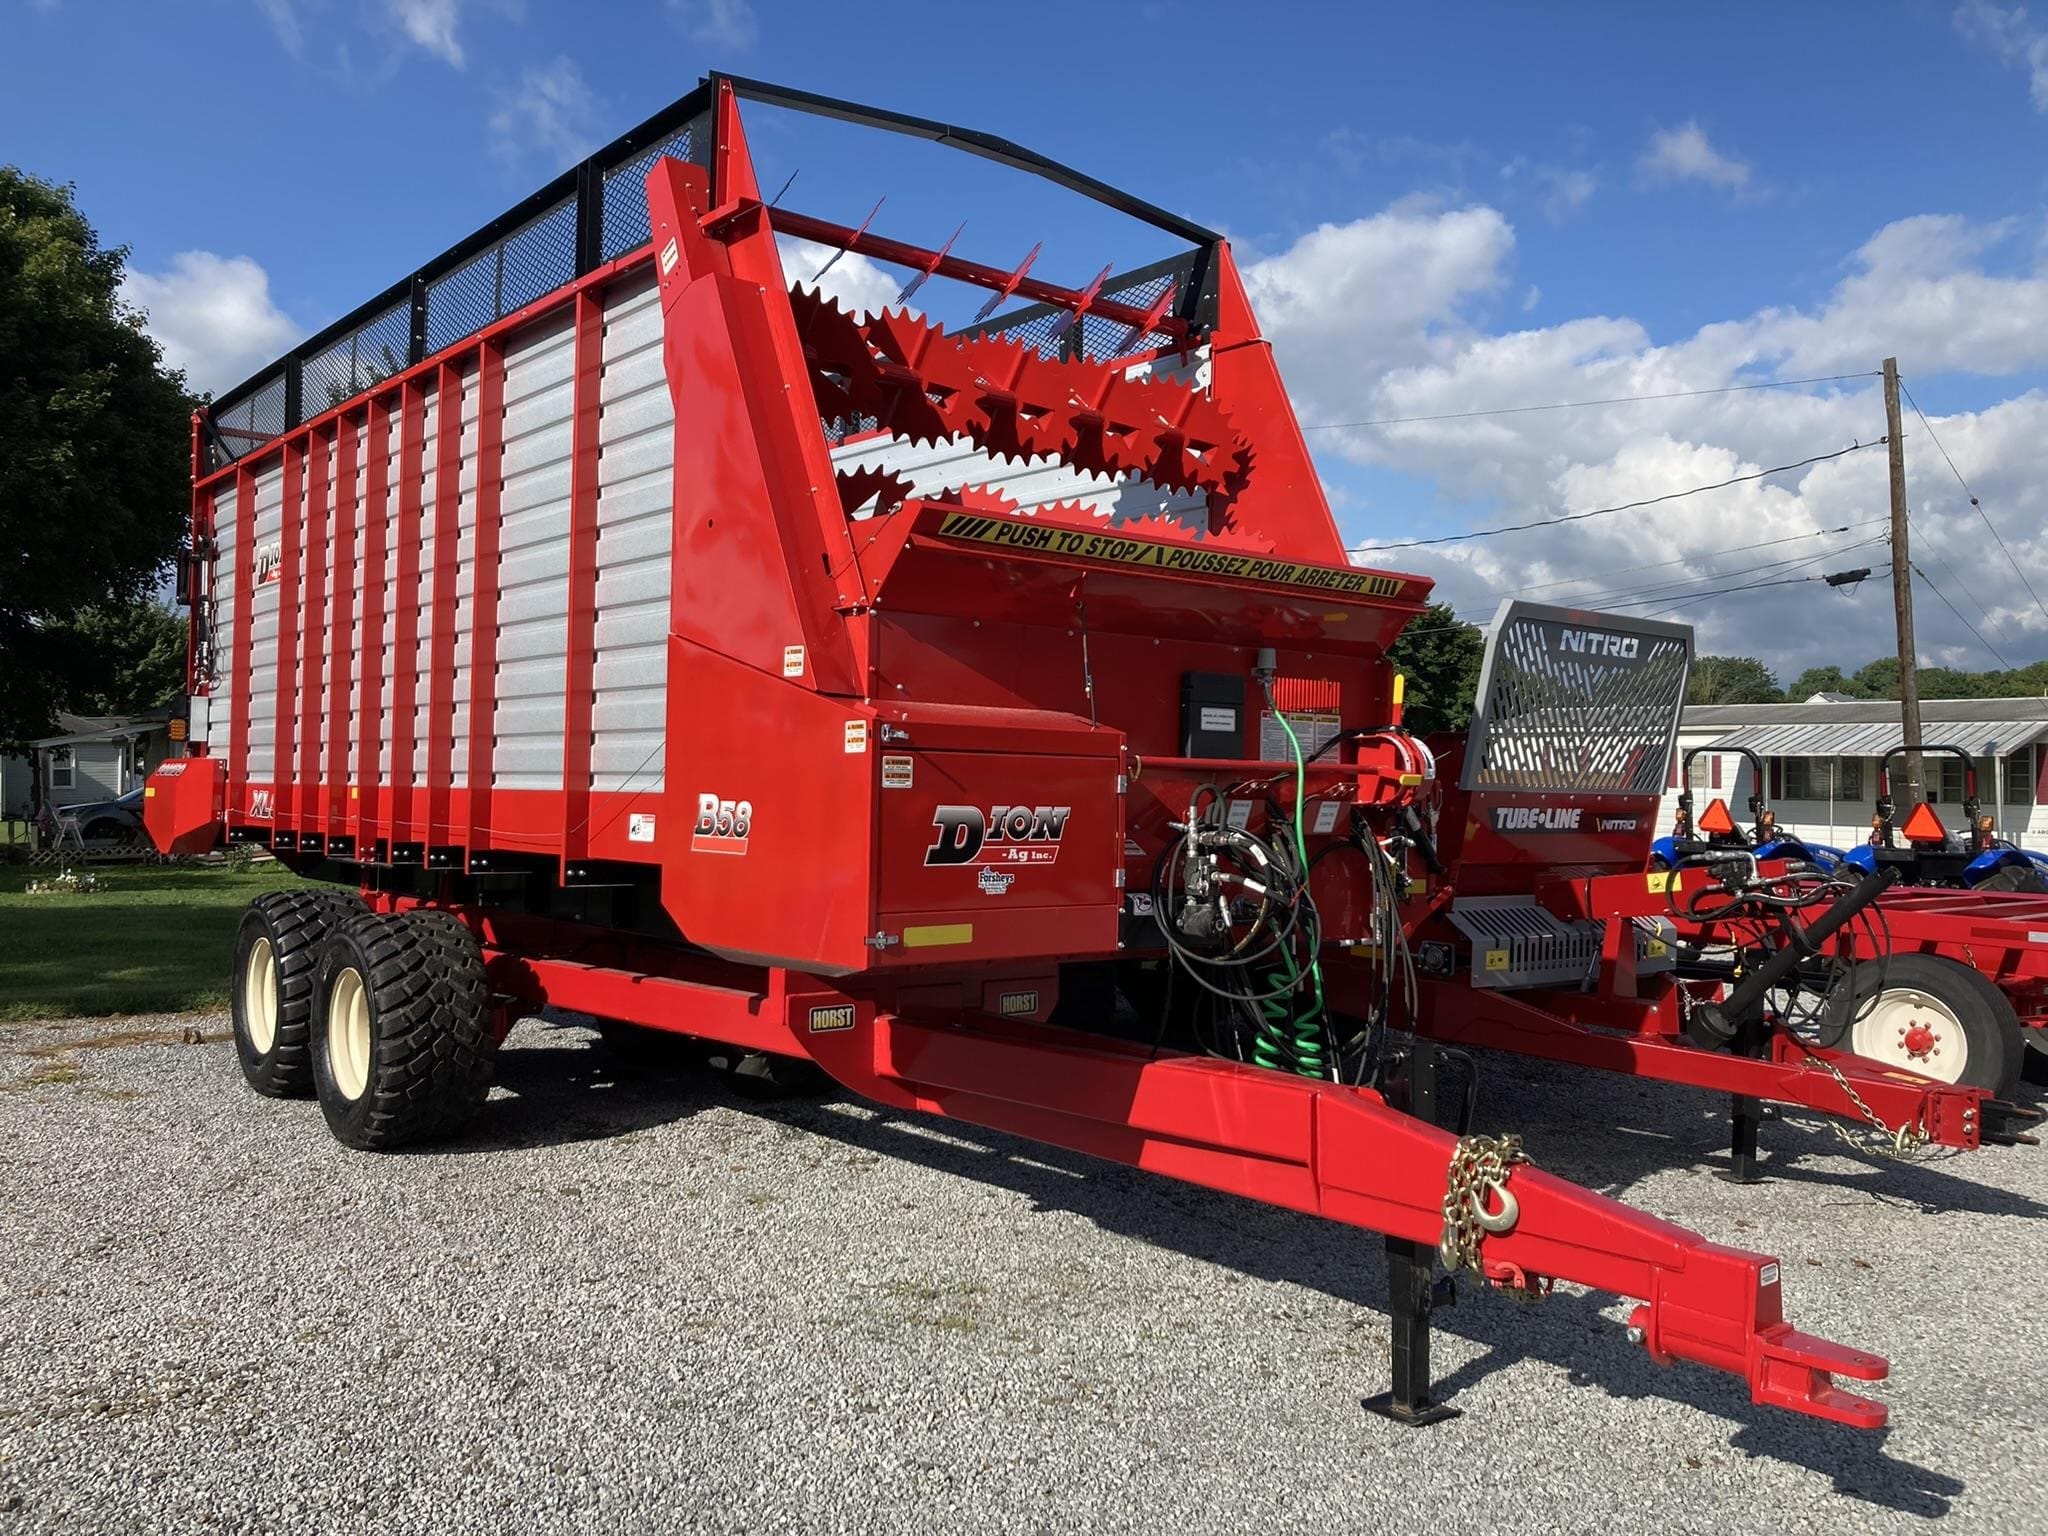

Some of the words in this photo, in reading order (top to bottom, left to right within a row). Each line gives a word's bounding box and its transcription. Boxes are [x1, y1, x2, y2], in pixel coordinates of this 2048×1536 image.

[994, 521, 1054, 548] PUSH
[1056, 531, 1086, 553] TO
[1085, 535, 1137, 560] STOP
[1166, 549, 1248, 575] POUSSEZ
[1248, 559, 1296, 582] POUR
[1559, 629, 1640, 659] NITRO
[694, 793, 752, 838] B58
[1602, 819, 1637, 830] NITRO
[924, 805, 1071, 866] DION
[1031, 851, 1053, 859] Inc.
[979, 872, 1015, 883] Forsheys
[1003, 994, 1036, 1012] HORST
[813, 1008, 853, 1029] HORST
